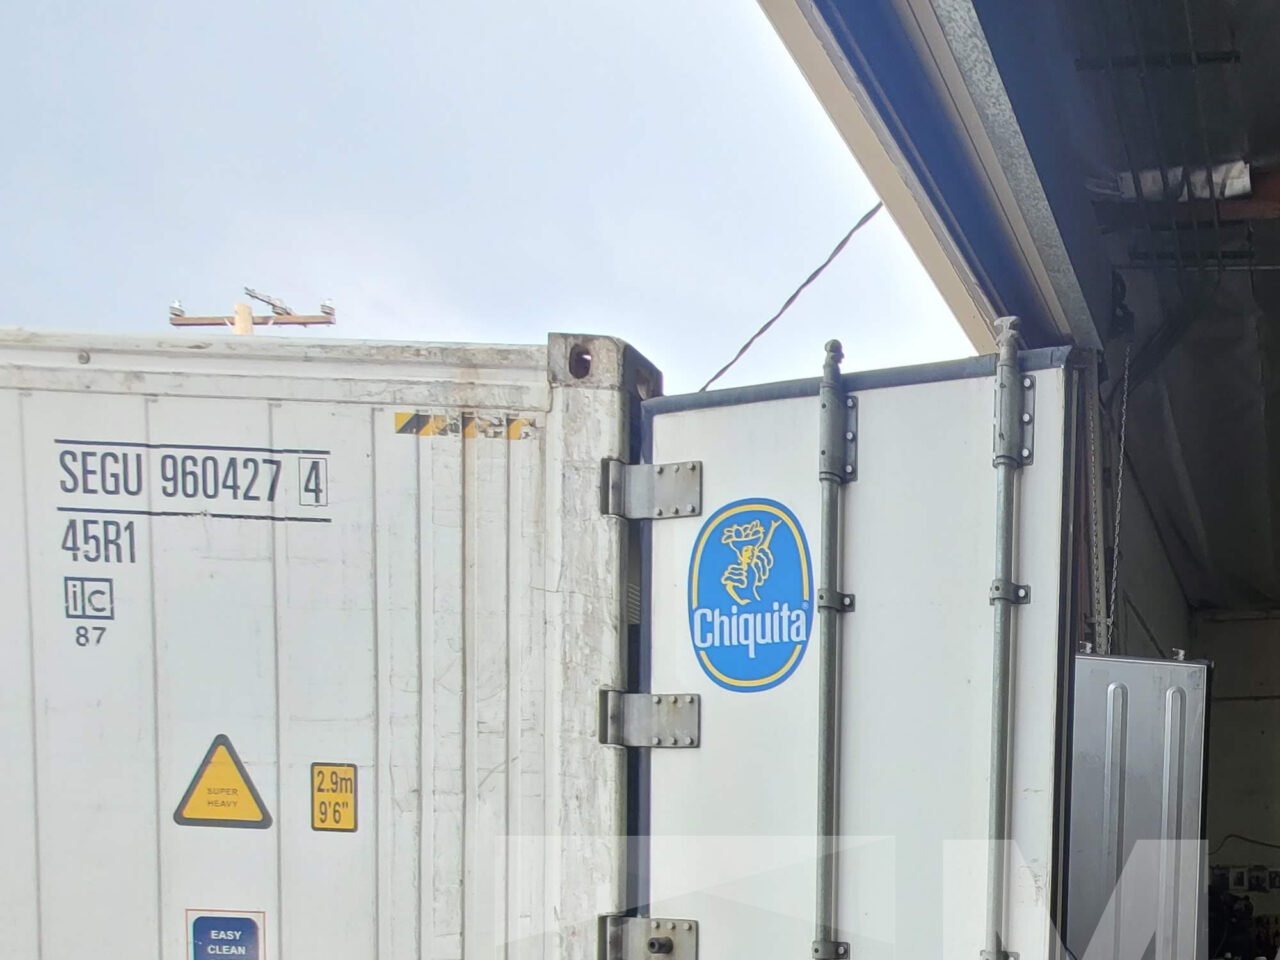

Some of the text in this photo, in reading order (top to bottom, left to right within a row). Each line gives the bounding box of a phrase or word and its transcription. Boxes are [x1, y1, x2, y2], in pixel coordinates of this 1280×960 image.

[59, 450, 322, 503] SEGU 960427 4
[61, 518, 136, 564] 45R1
[75, 626, 107, 647] 87
[693, 601, 807, 659] Chiquita
[207, 787, 239, 797] SUPER
[316, 770, 353, 794] 2.9m
[207, 799, 238, 809] HEAVY
[210, 930, 242, 941] EASY
[207, 944, 246, 956] CLEAN
